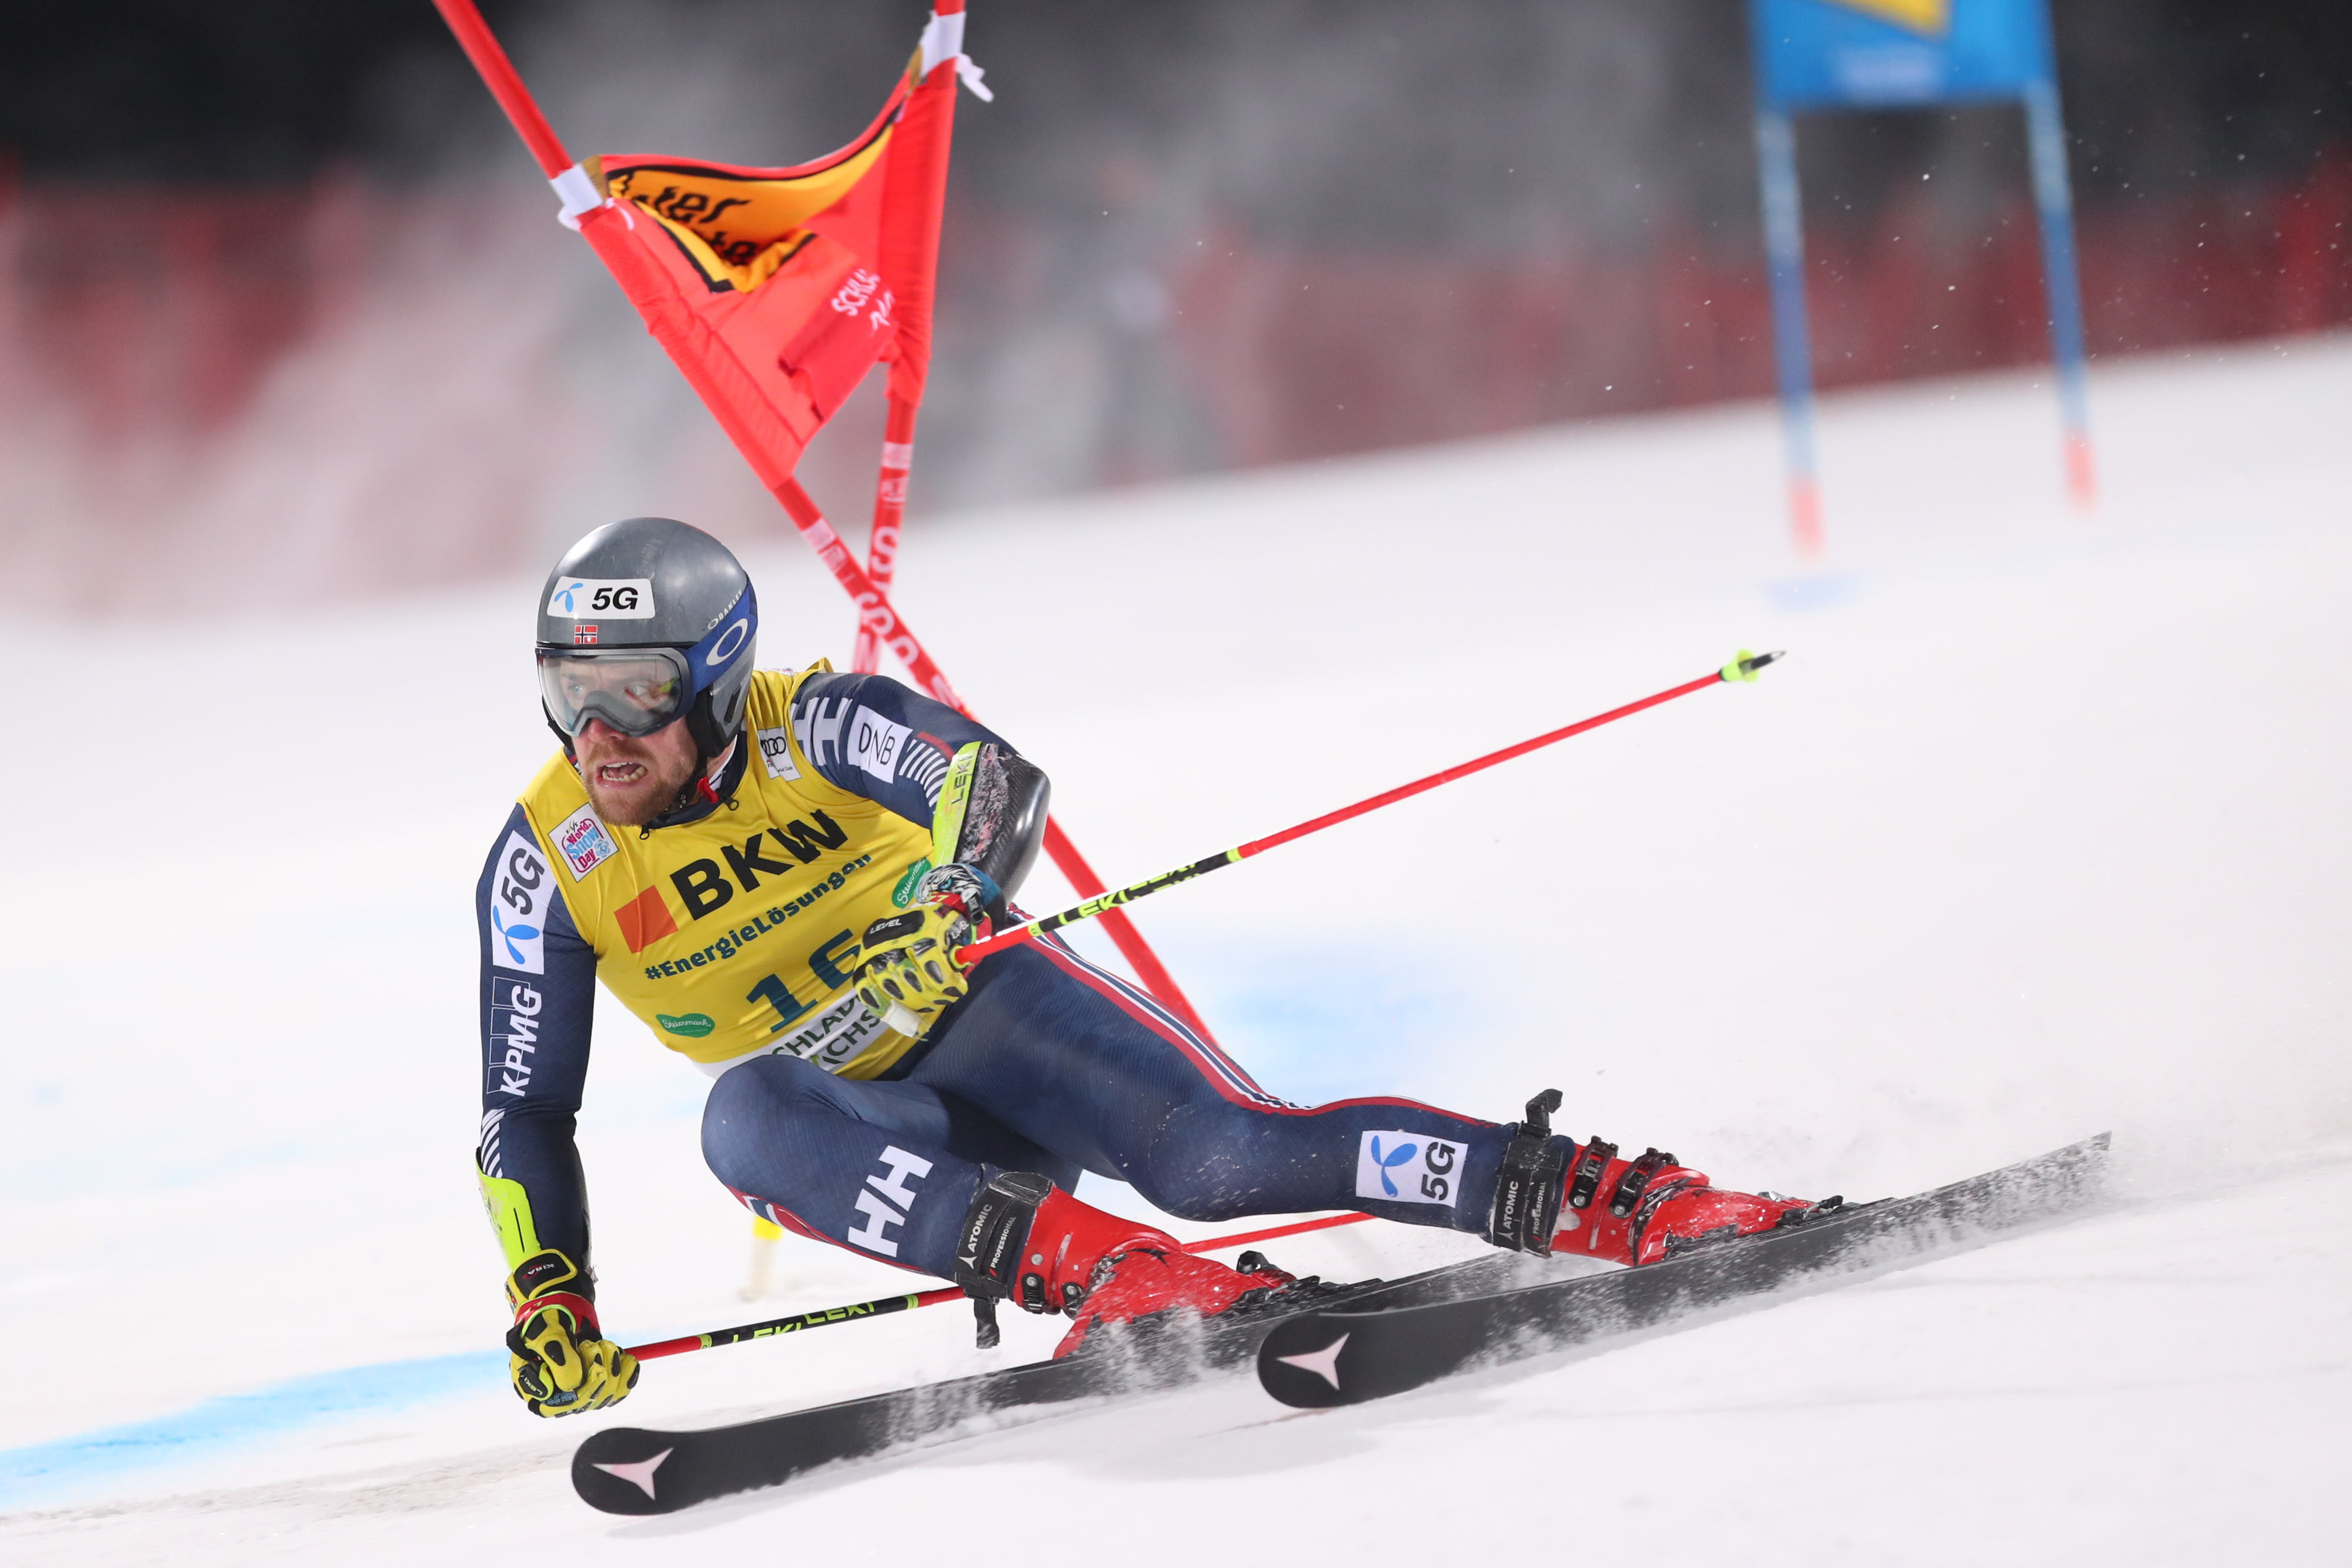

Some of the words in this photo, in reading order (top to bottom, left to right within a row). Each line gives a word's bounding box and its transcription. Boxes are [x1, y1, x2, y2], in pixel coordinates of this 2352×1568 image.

[592, 587, 639, 610] 5G
[719, 589, 742, 620] OAKLEY
[858, 723, 895, 770] DNB
[951, 754, 973, 805] LEKI
[566, 827, 599, 860] Snow
[577, 848, 596, 869] Day
[670, 809, 848, 921] BKW
[501, 848, 546, 915] 5G
[644, 854, 871, 980] #EnergieLösungen
[869, 918, 902, 934] LEVEL
[746, 928, 861, 1033] 16
[500, 984, 543, 1097] KPMG
[662, 1018, 711, 1028] Steiermark
[1421, 1141, 1456, 1202] 5G
[847, 1145, 934, 1258] HH
[1502, 1181, 1519, 1230] ATOMIC
[1532, 1182, 1547, 1235] PROFESSIONAL
[967, 1203, 993, 1253] ATOMIC
[990, 1216, 1017, 1269] PROFESSIONAL
[803, 1302, 875, 1325] LEKI
